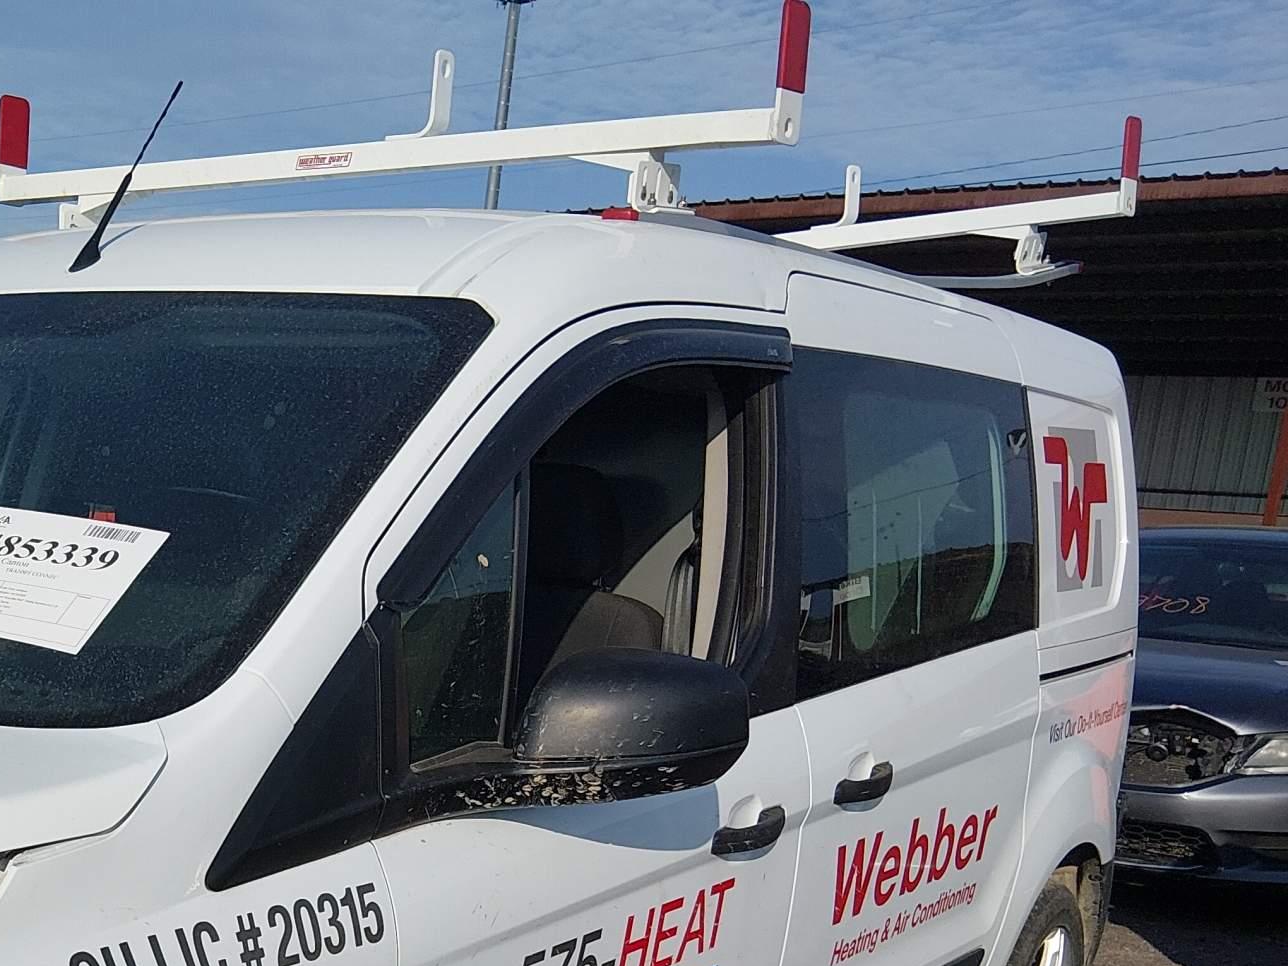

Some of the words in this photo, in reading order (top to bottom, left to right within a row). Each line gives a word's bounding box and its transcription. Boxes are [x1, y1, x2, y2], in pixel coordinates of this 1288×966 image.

[0, 558, 30, 567] Canton
[1049, 721, 1064, 744] Visit
[1064, 719, 1077, 739] Our
[832, 804, 999, 925] Webber
[829, 928, 880, 966] Heating
[880, 918, 892, 943] &
[892, 911, 911, 940] Air
[911, 882, 978, 929] Conditioning
